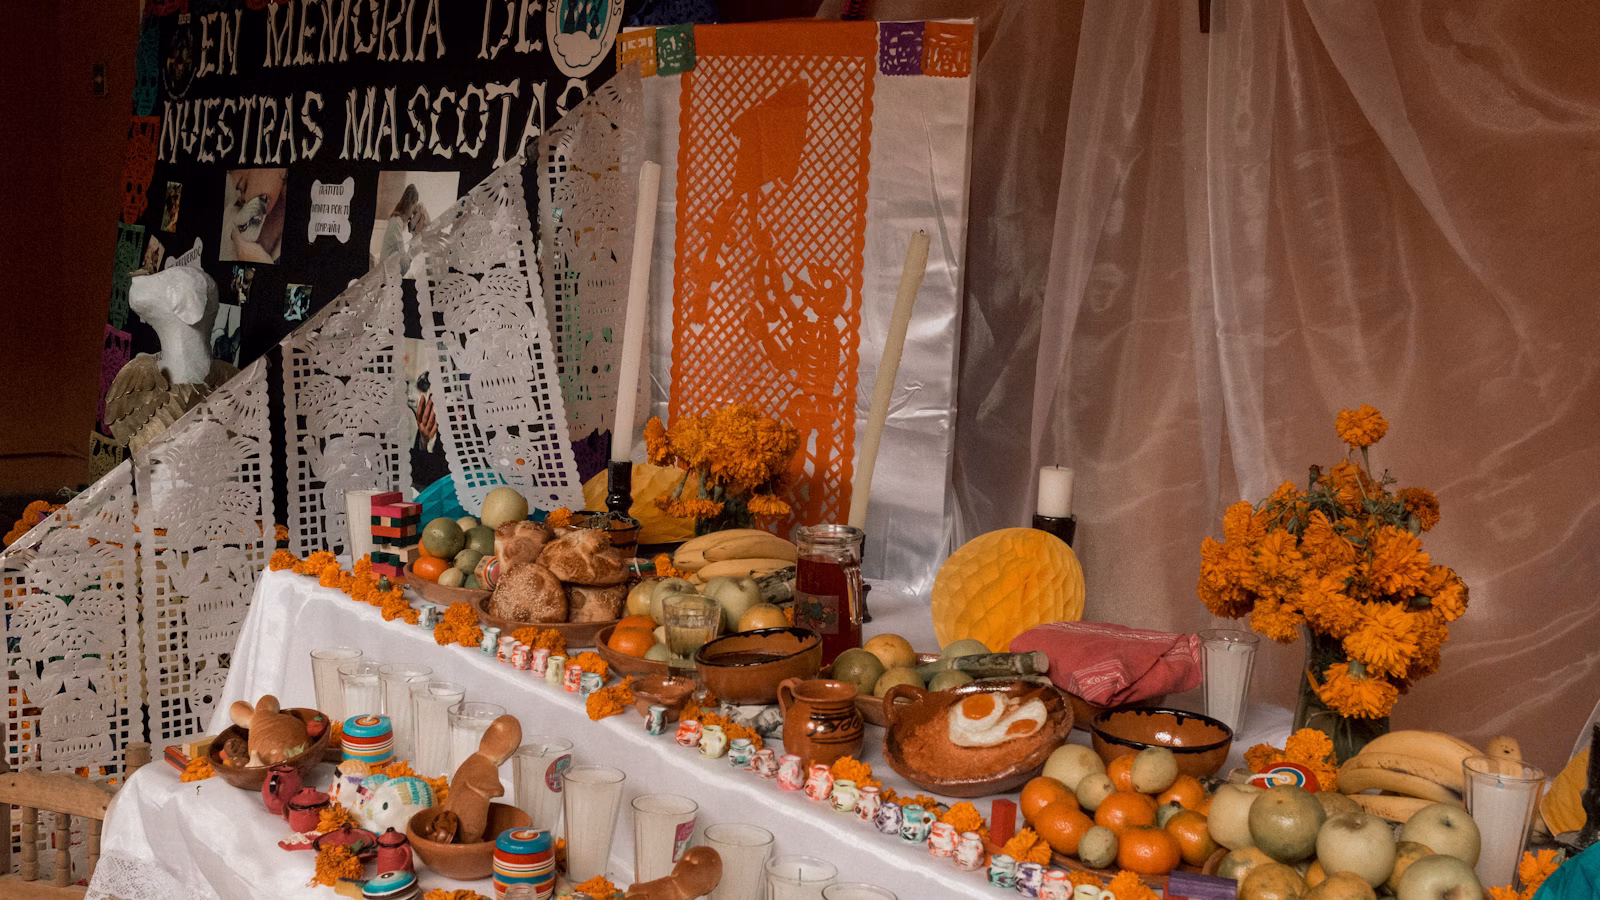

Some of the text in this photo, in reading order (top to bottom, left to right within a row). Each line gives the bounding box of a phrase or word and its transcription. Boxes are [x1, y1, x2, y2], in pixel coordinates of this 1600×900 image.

[196, 0, 542, 78] EN MEMORIA DE
[157, 89, 325, 164] NUESTRAS
